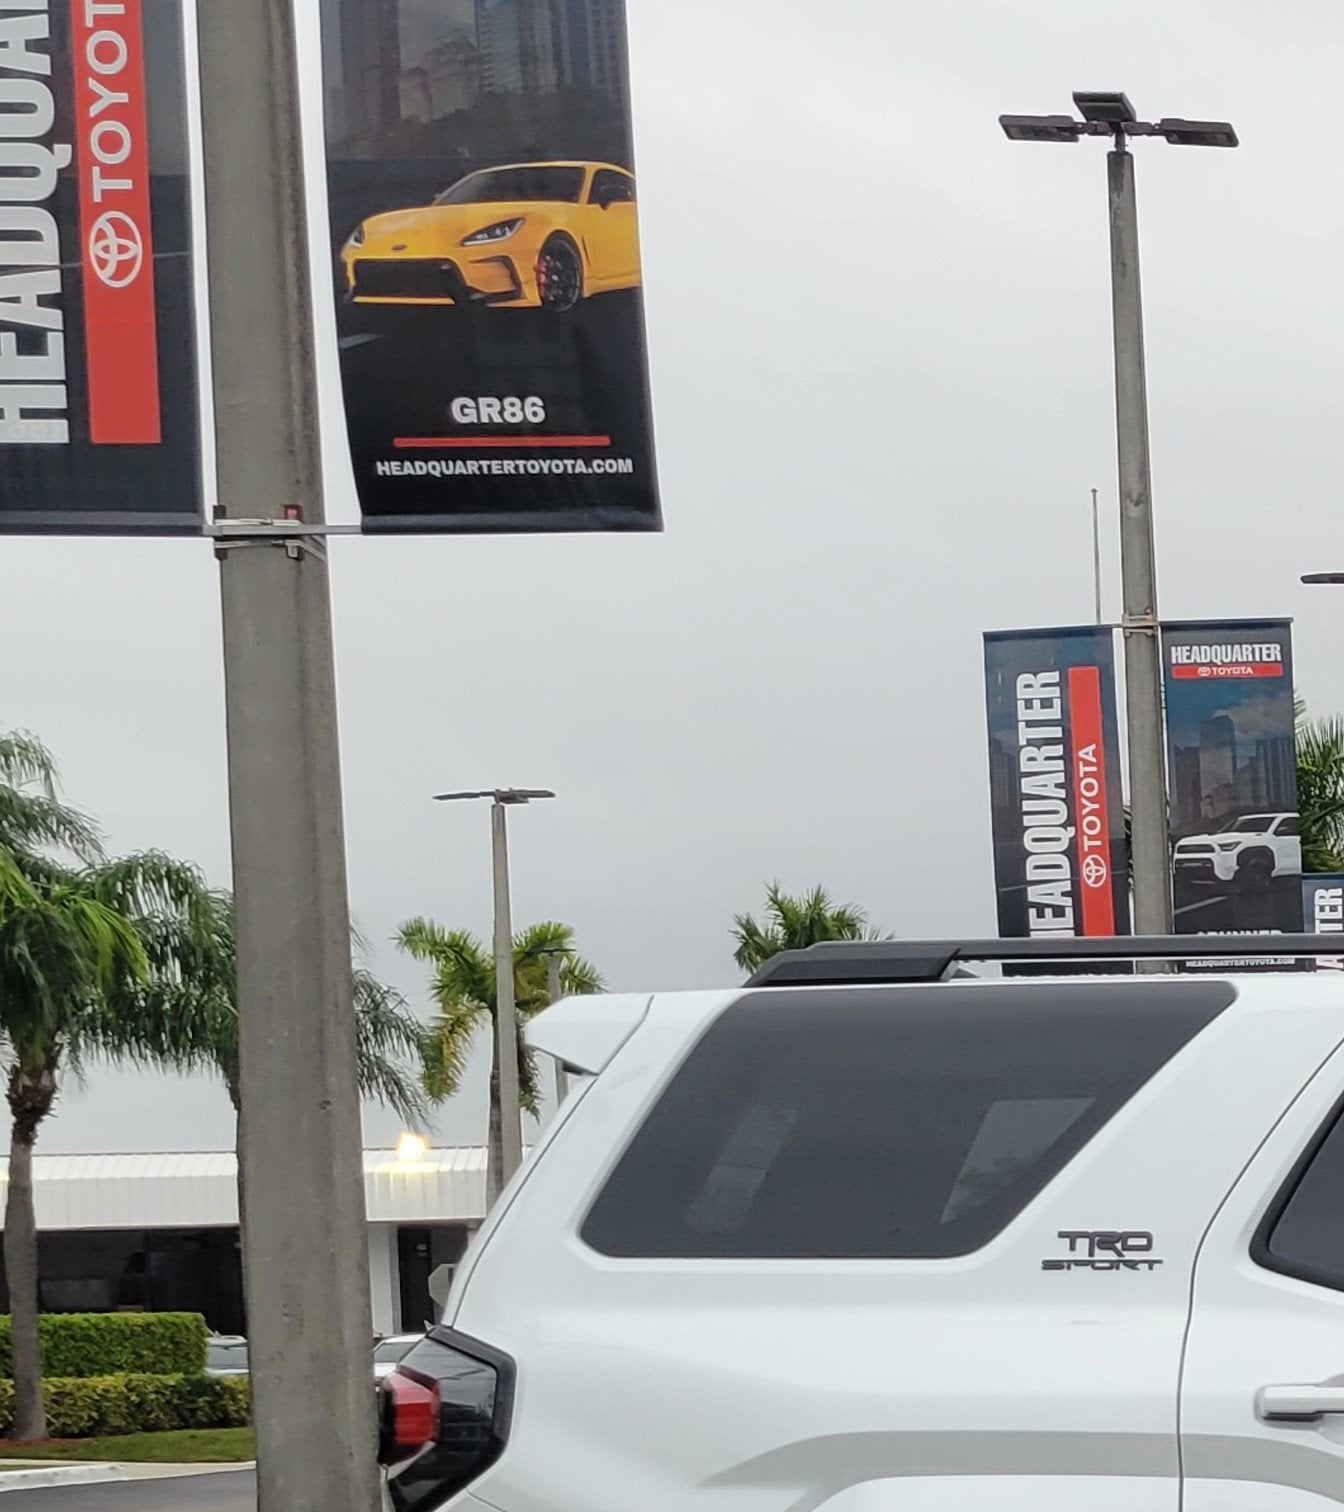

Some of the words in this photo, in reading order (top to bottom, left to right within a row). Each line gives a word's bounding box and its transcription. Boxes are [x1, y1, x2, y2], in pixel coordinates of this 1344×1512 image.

[450, 396, 546, 424] GR86
[376, 458, 634, 477] HEADQUARTERTOYOTA.COM
[1169, 643, 1281, 664] HEADQUARTER
[1212, 666, 1253, 676] TOYOTA
[1078, 743, 1102, 852] TOYOTA
[1057, 1231, 1153, 1258] TRD
[1041, 1259, 1163, 1271] SPORT
